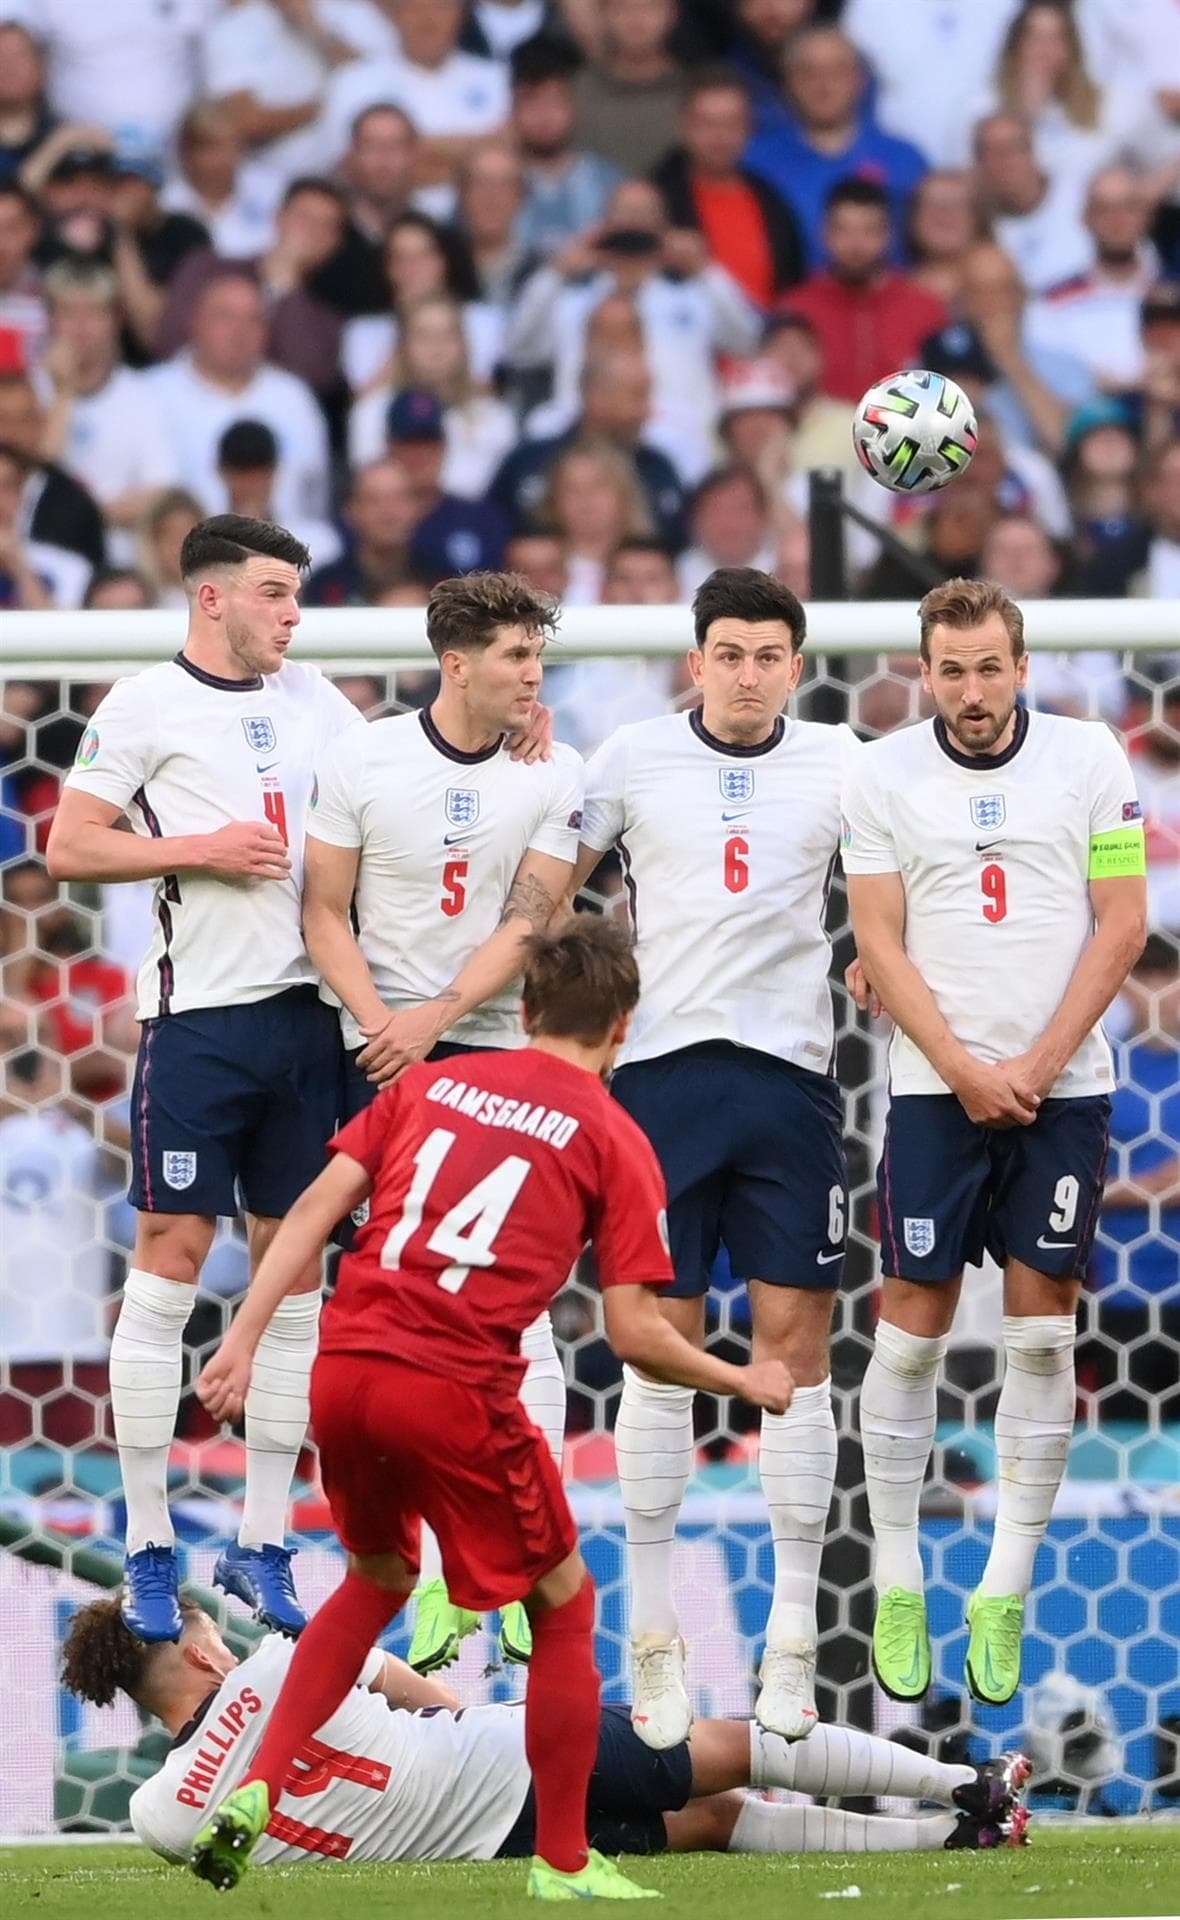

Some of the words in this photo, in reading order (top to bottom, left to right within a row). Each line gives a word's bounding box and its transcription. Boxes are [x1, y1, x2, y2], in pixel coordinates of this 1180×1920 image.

[263, 791, 289, 848] 4
[441, 861, 468, 917] 5
[724, 836, 749, 894] 6
[981, 864, 1007, 923] 9
[425, 1076, 580, 1151] DAMSGAARD
[379, 1127, 532, 1295] 14
[828, 1184, 845, 1244] 6
[1049, 1175, 1079, 1233] 9
[175, 1686, 263, 1810] PHILLIPS
